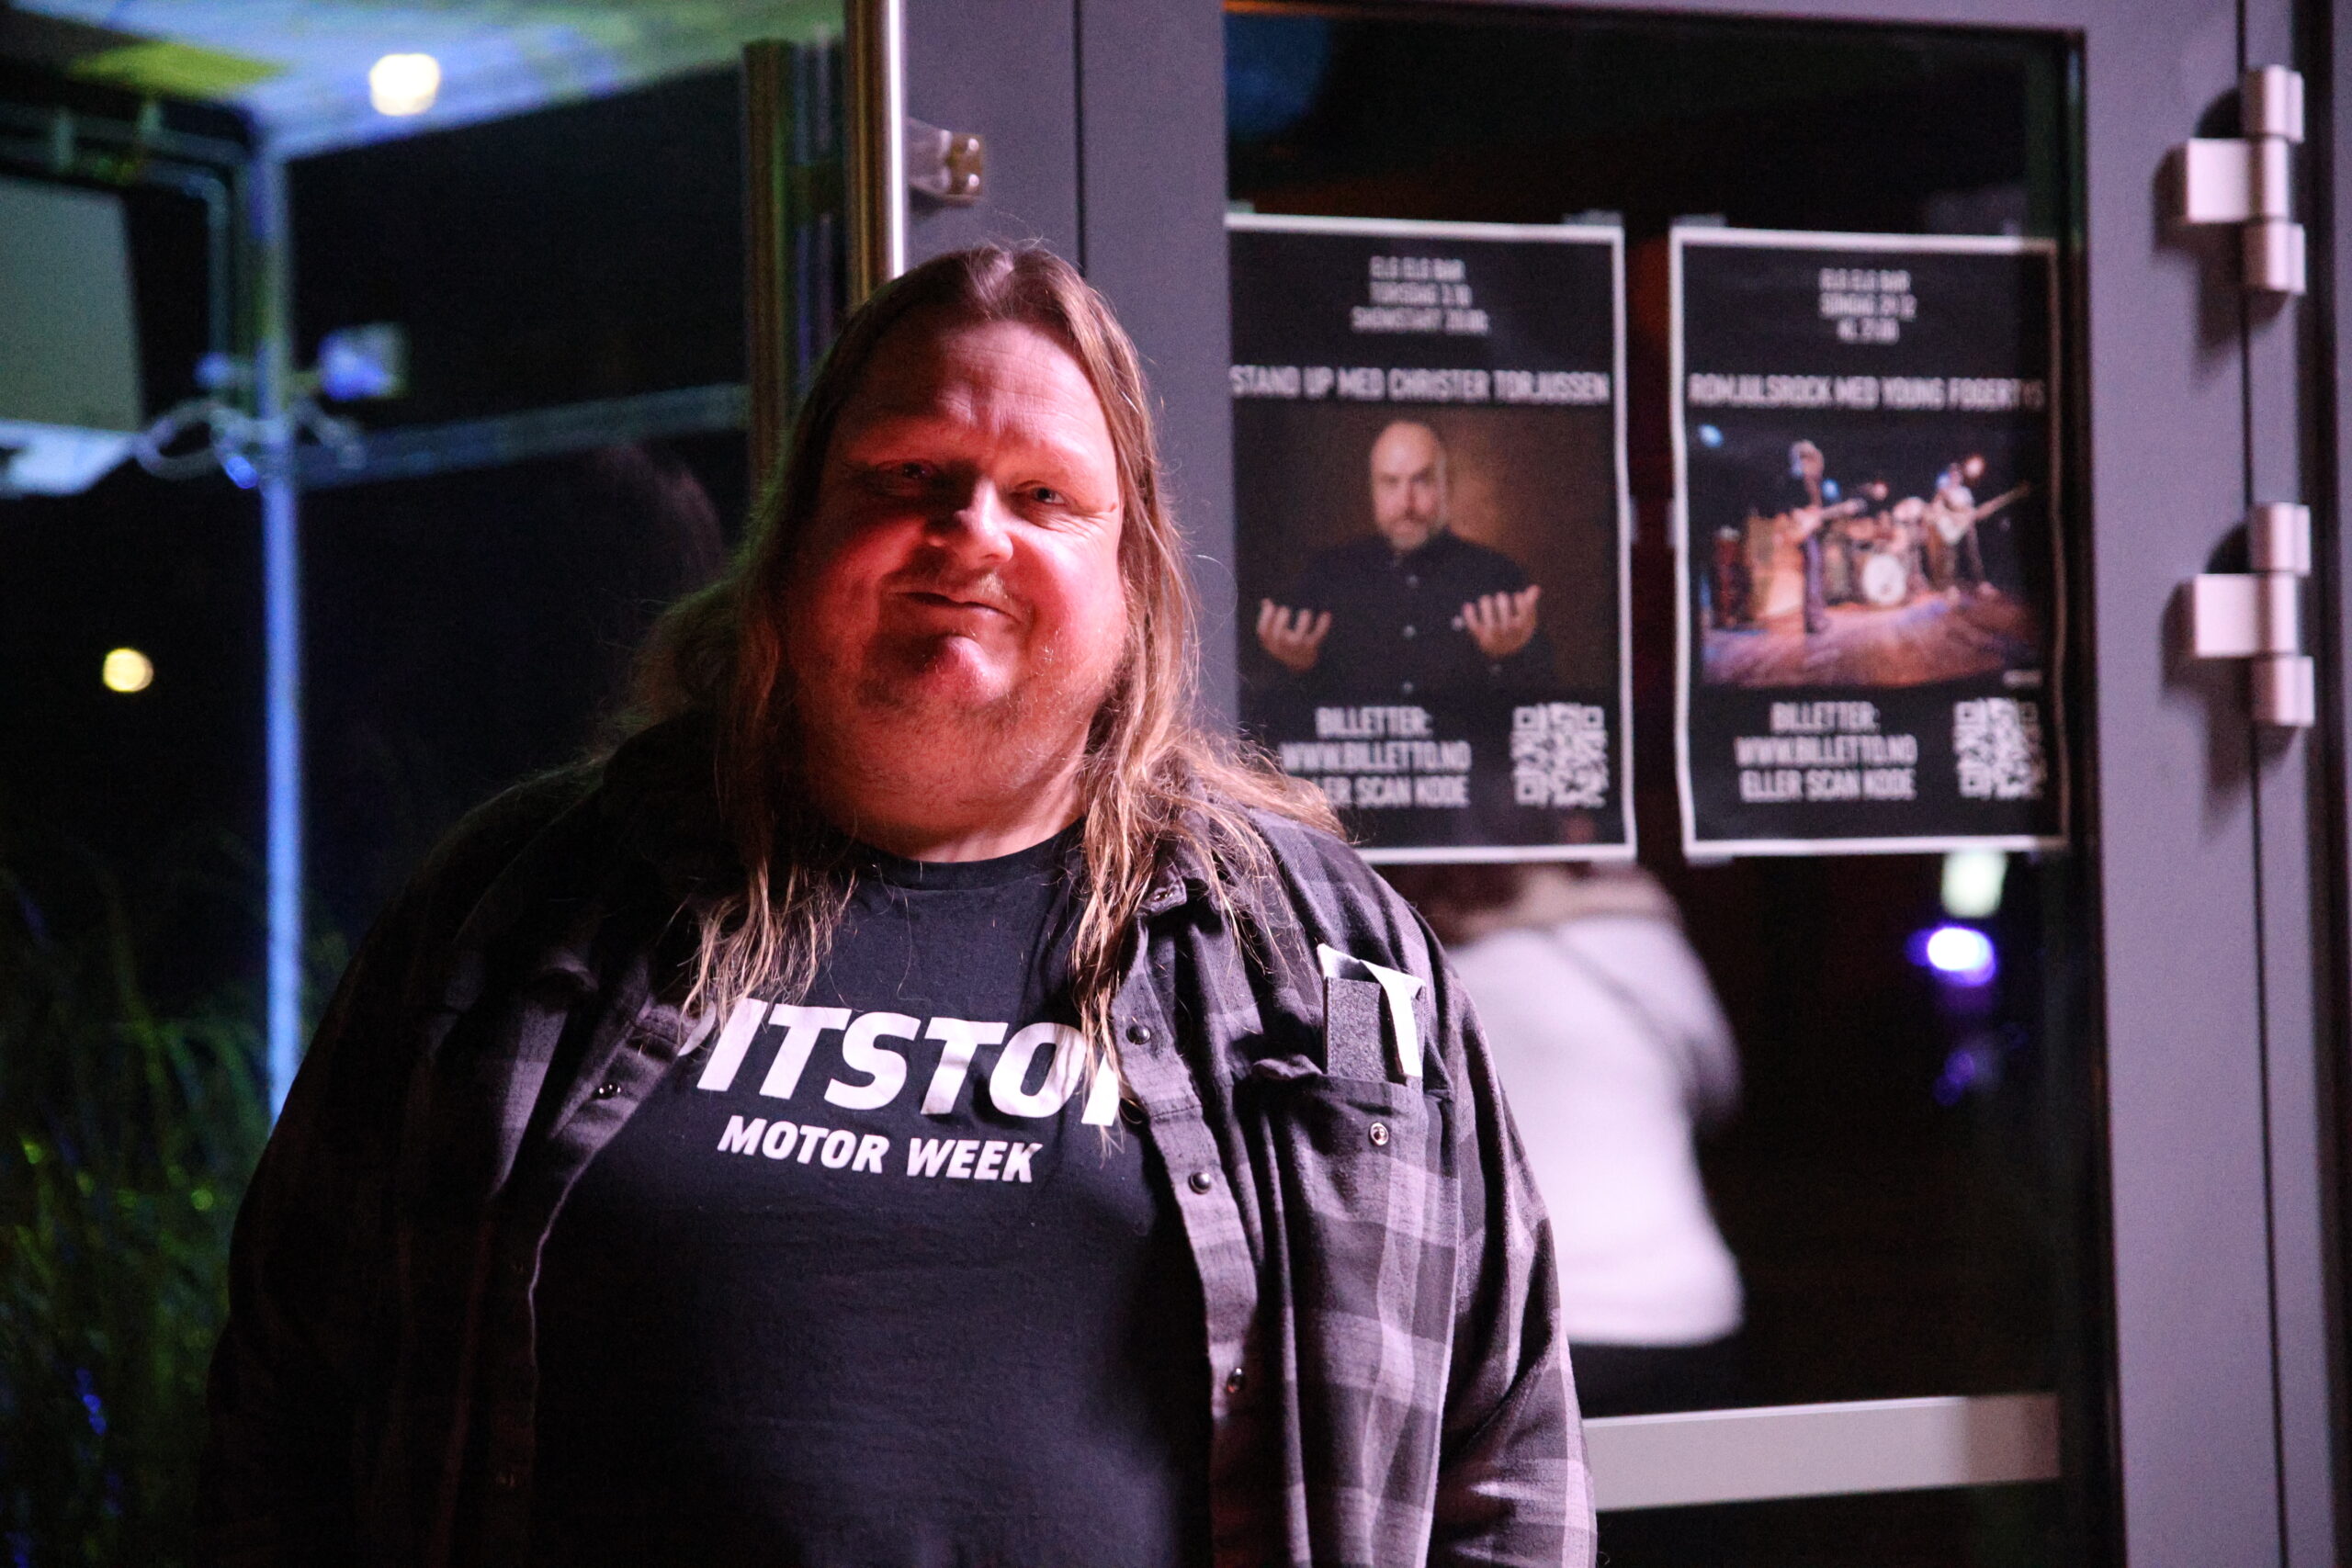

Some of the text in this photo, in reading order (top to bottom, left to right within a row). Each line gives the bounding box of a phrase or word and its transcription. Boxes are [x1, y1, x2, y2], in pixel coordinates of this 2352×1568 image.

[1230, 365, 1611, 404] STAND UP MED CHRISTER TORJUSSEN
[1687, 373, 1832, 408] ROMJULSROCK
[1835, 375, 1879, 410] MED
[1881, 377, 1945, 411] YOUNG
[1280, 740, 1471, 773] WWW.BILLETTO.NO
[1734, 735, 1918, 768] WWW.BILLETTO.NO
[1354, 776, 1412, 808] SCAN
[1413, 776, 1470, 808] KODE
[1740, 769, 1917, 802] ELLER SCAN KODE
[678, 998, 1120, 1127] ITSTO
[717, 1114, 1043, 1183] MOTOR WEEK
